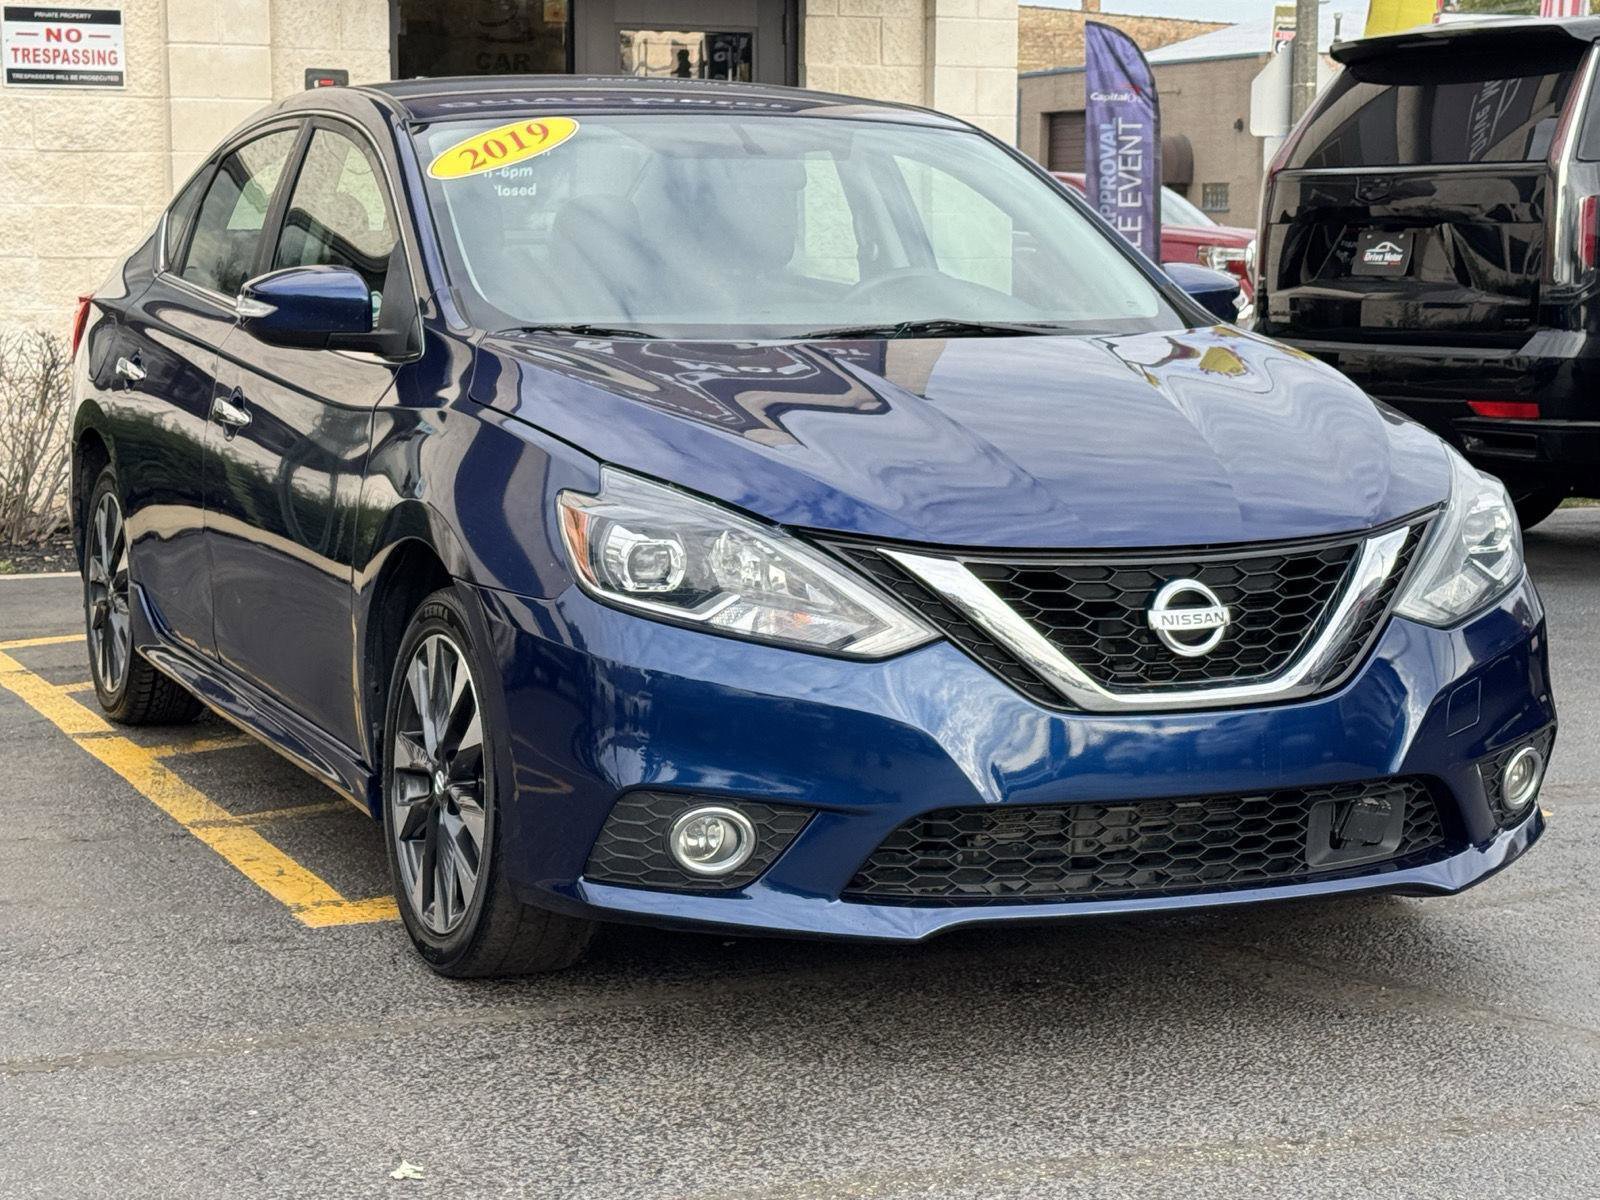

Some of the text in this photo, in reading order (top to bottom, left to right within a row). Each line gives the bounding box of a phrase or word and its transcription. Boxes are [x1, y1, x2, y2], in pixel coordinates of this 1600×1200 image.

[45, 28, 82, 43] NO
[11, 48, 118, 65] TRESPASSING
[459, 123, 549, 170] 2019
[1118, 117, 1142, 208] EVENT
[1161, 612, 1224, 625] NISSAN
